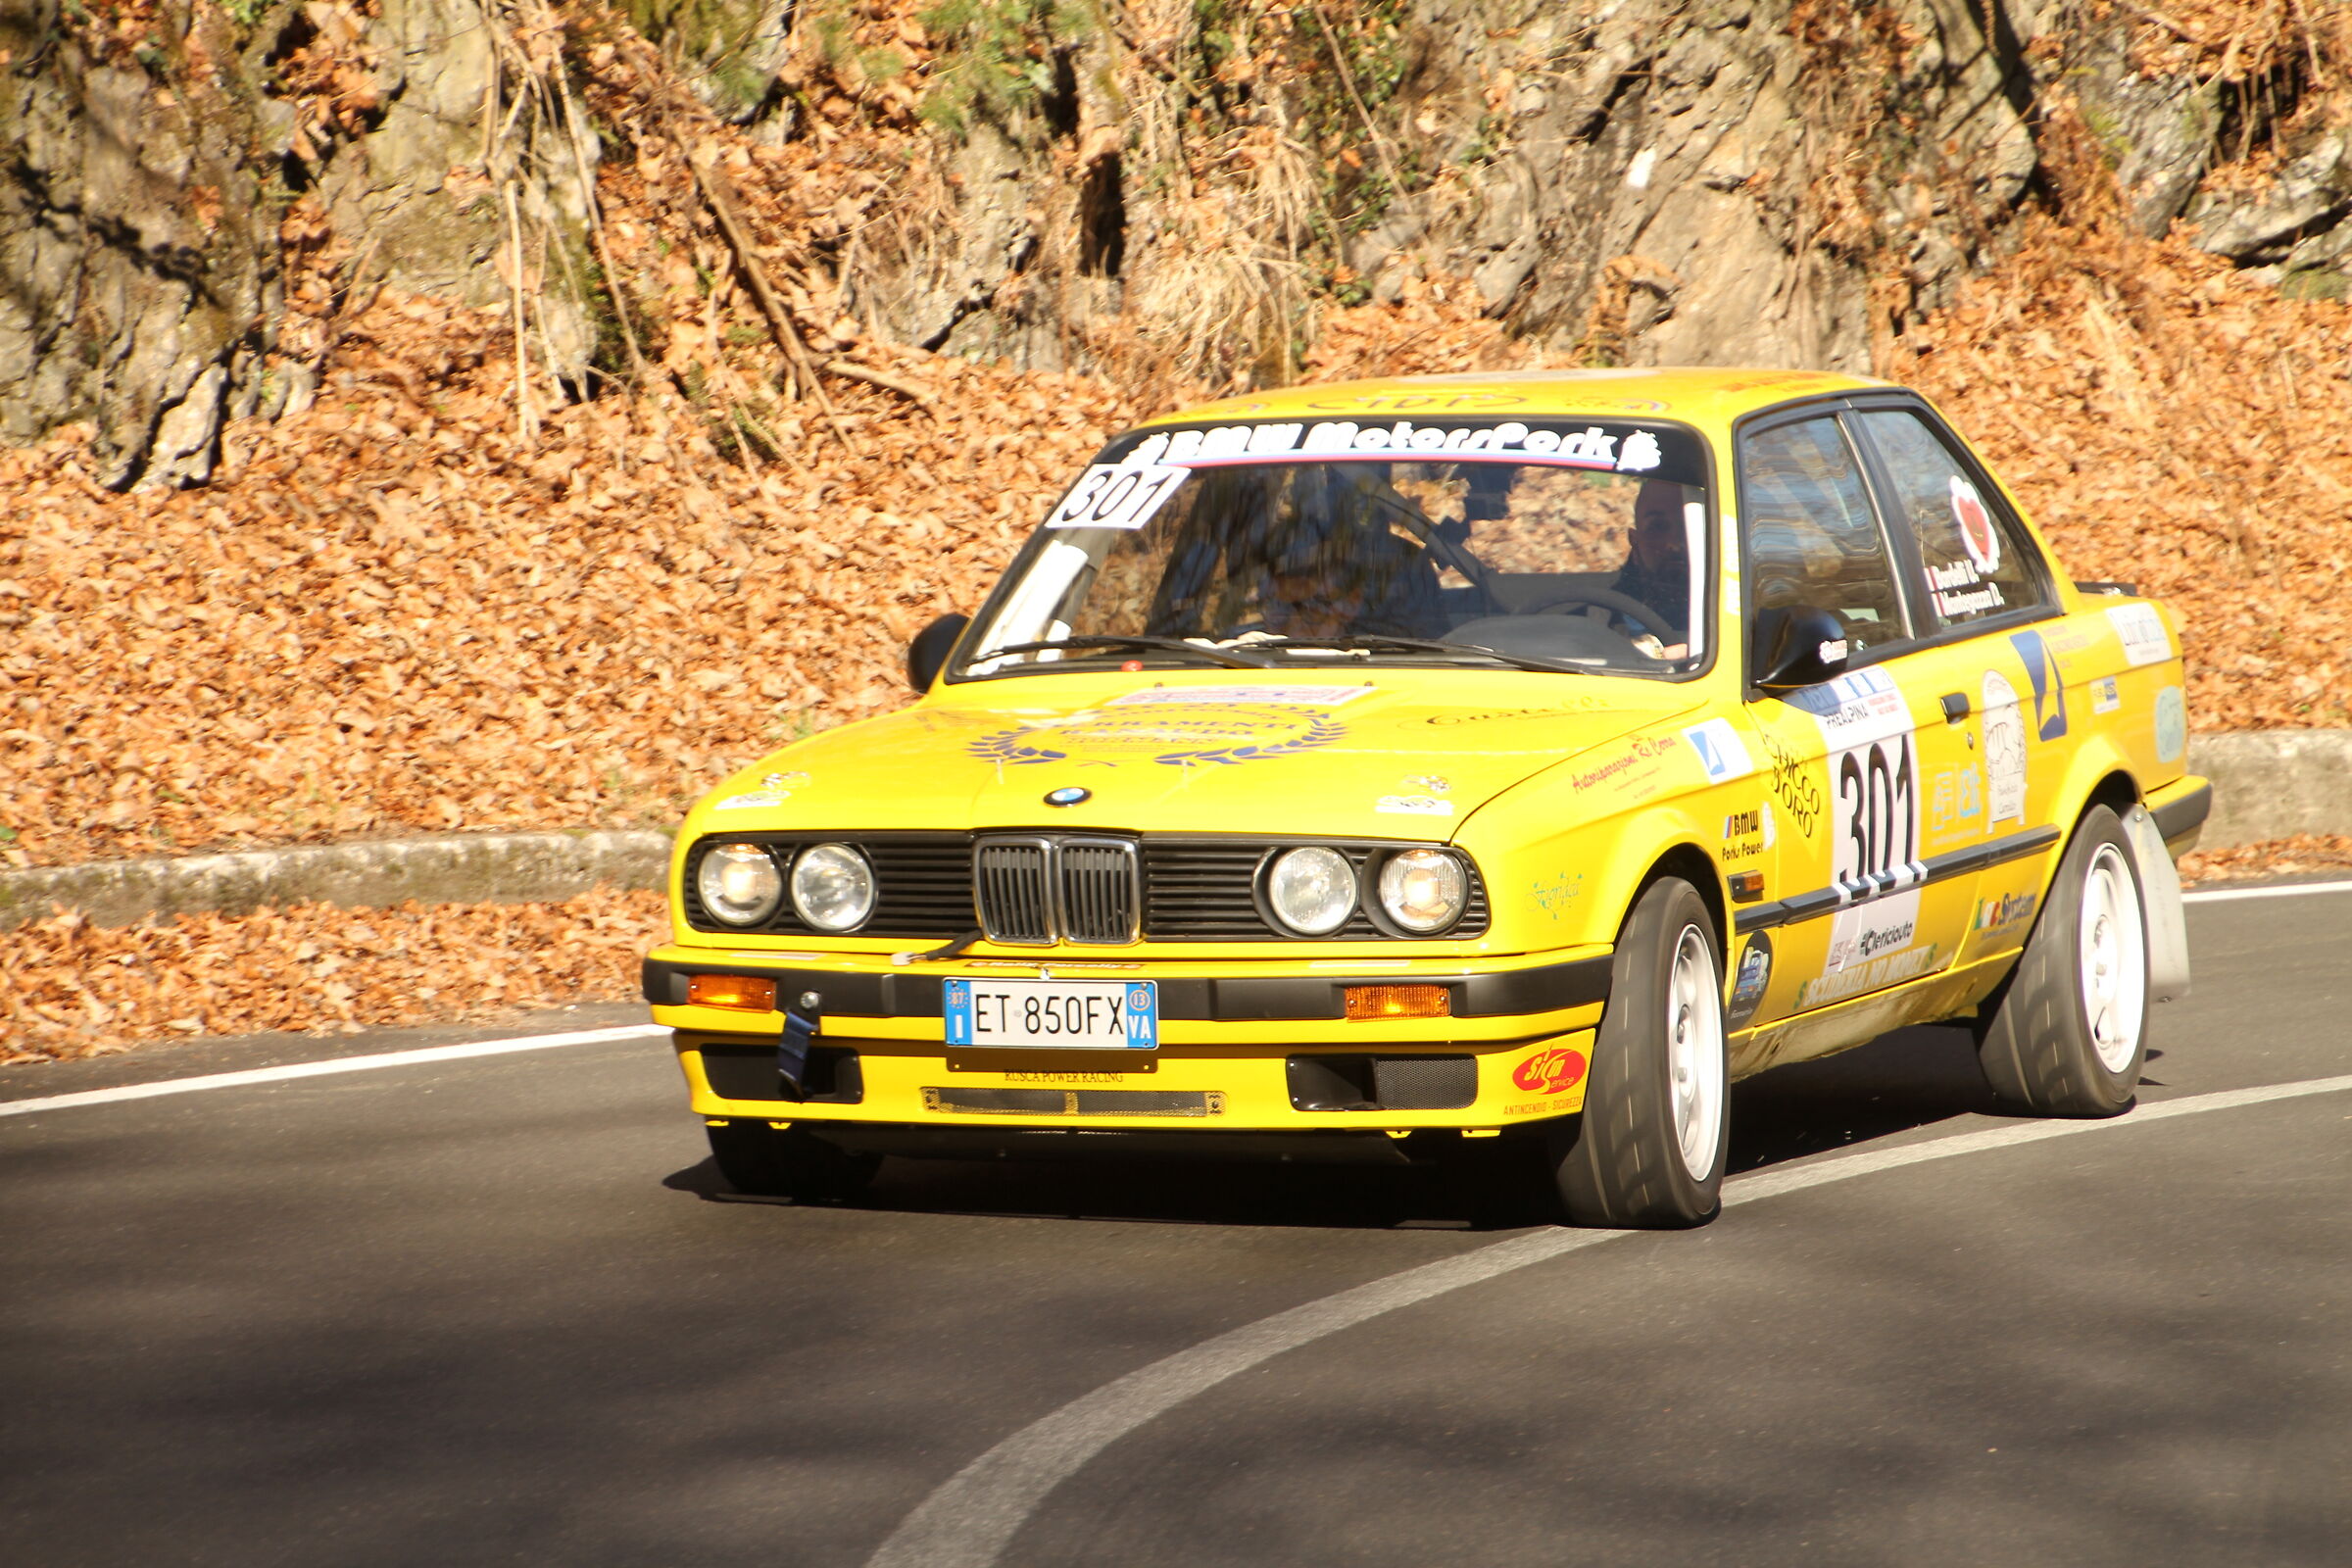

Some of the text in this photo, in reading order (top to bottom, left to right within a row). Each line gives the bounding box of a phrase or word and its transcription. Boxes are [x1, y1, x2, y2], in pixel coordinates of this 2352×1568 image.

[1167, 422, 1304, 461] BMW
[1061, 468, 1160, 522] 301
[1733, 809, 1759, 837] BMW
[1839, 733, 1922, 902] 301
[956, 1013, 964, 1039] I
[975, 994, 1125, 1035] ET 850FX
[1128, 1014, 1152, 1039] VA
[1042, 1069, 1079, 1083] POWER
[1082, 1069, 1124, 1083] RACING
